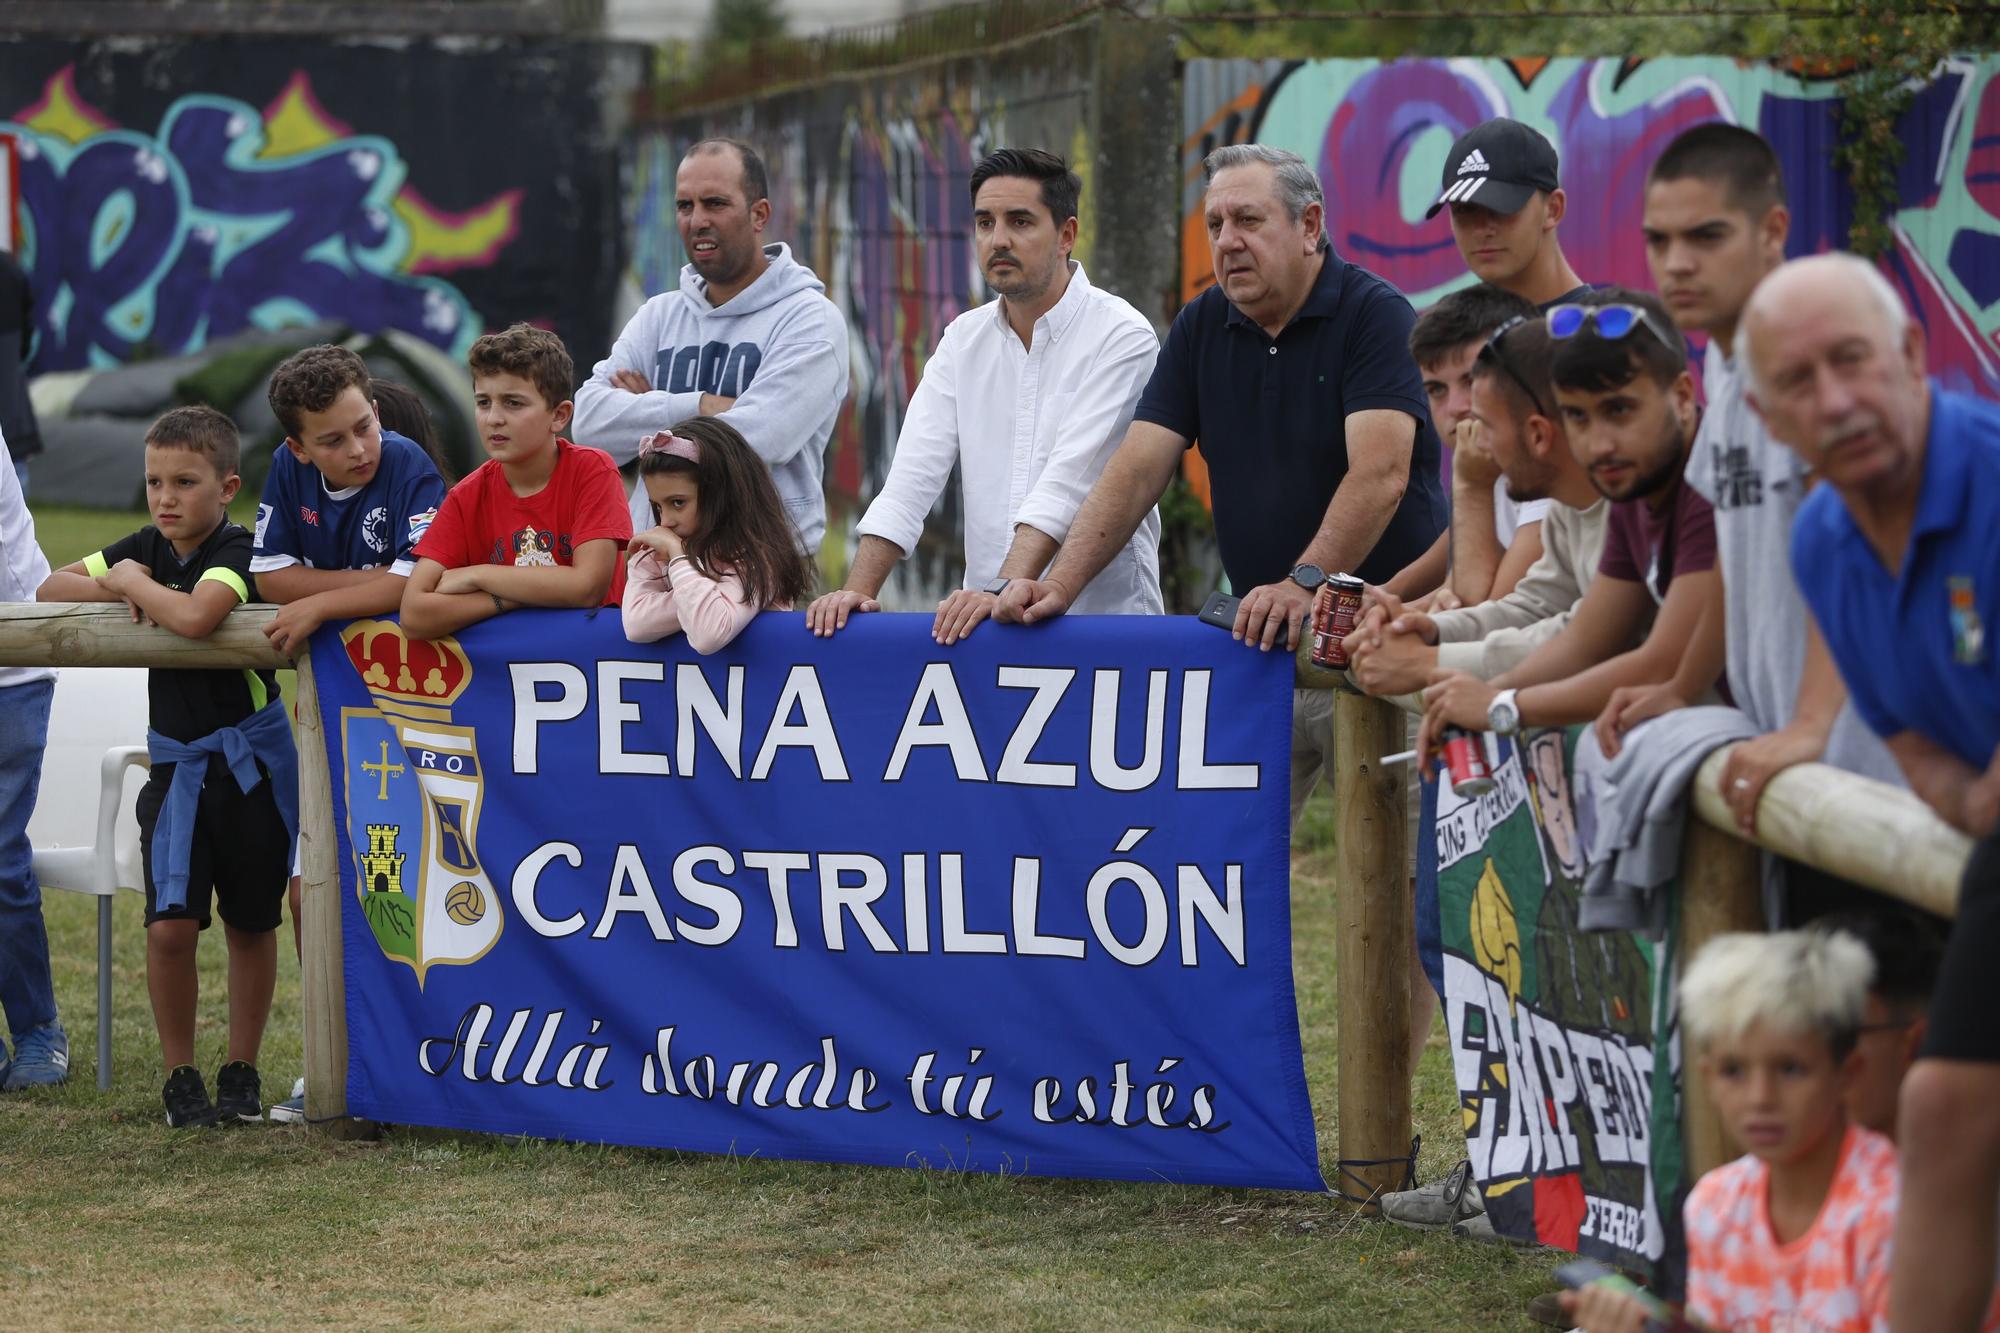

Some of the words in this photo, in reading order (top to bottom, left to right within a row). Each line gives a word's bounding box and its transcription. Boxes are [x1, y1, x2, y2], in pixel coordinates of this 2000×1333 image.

[1457, 163, 1490, 175] adidas
[508, 659, 851, 781] PENA
[882, 662, 1260, 792] AZUL
[510, 827, 1247, 967] CASTRILLÓN
[418, 1002, 613, 1091] Allá
[641, 1025, 891, 1112] donde
[904, 1048, 1002, 1121] tú
[1033, 1057, 1231, 1134] estés
